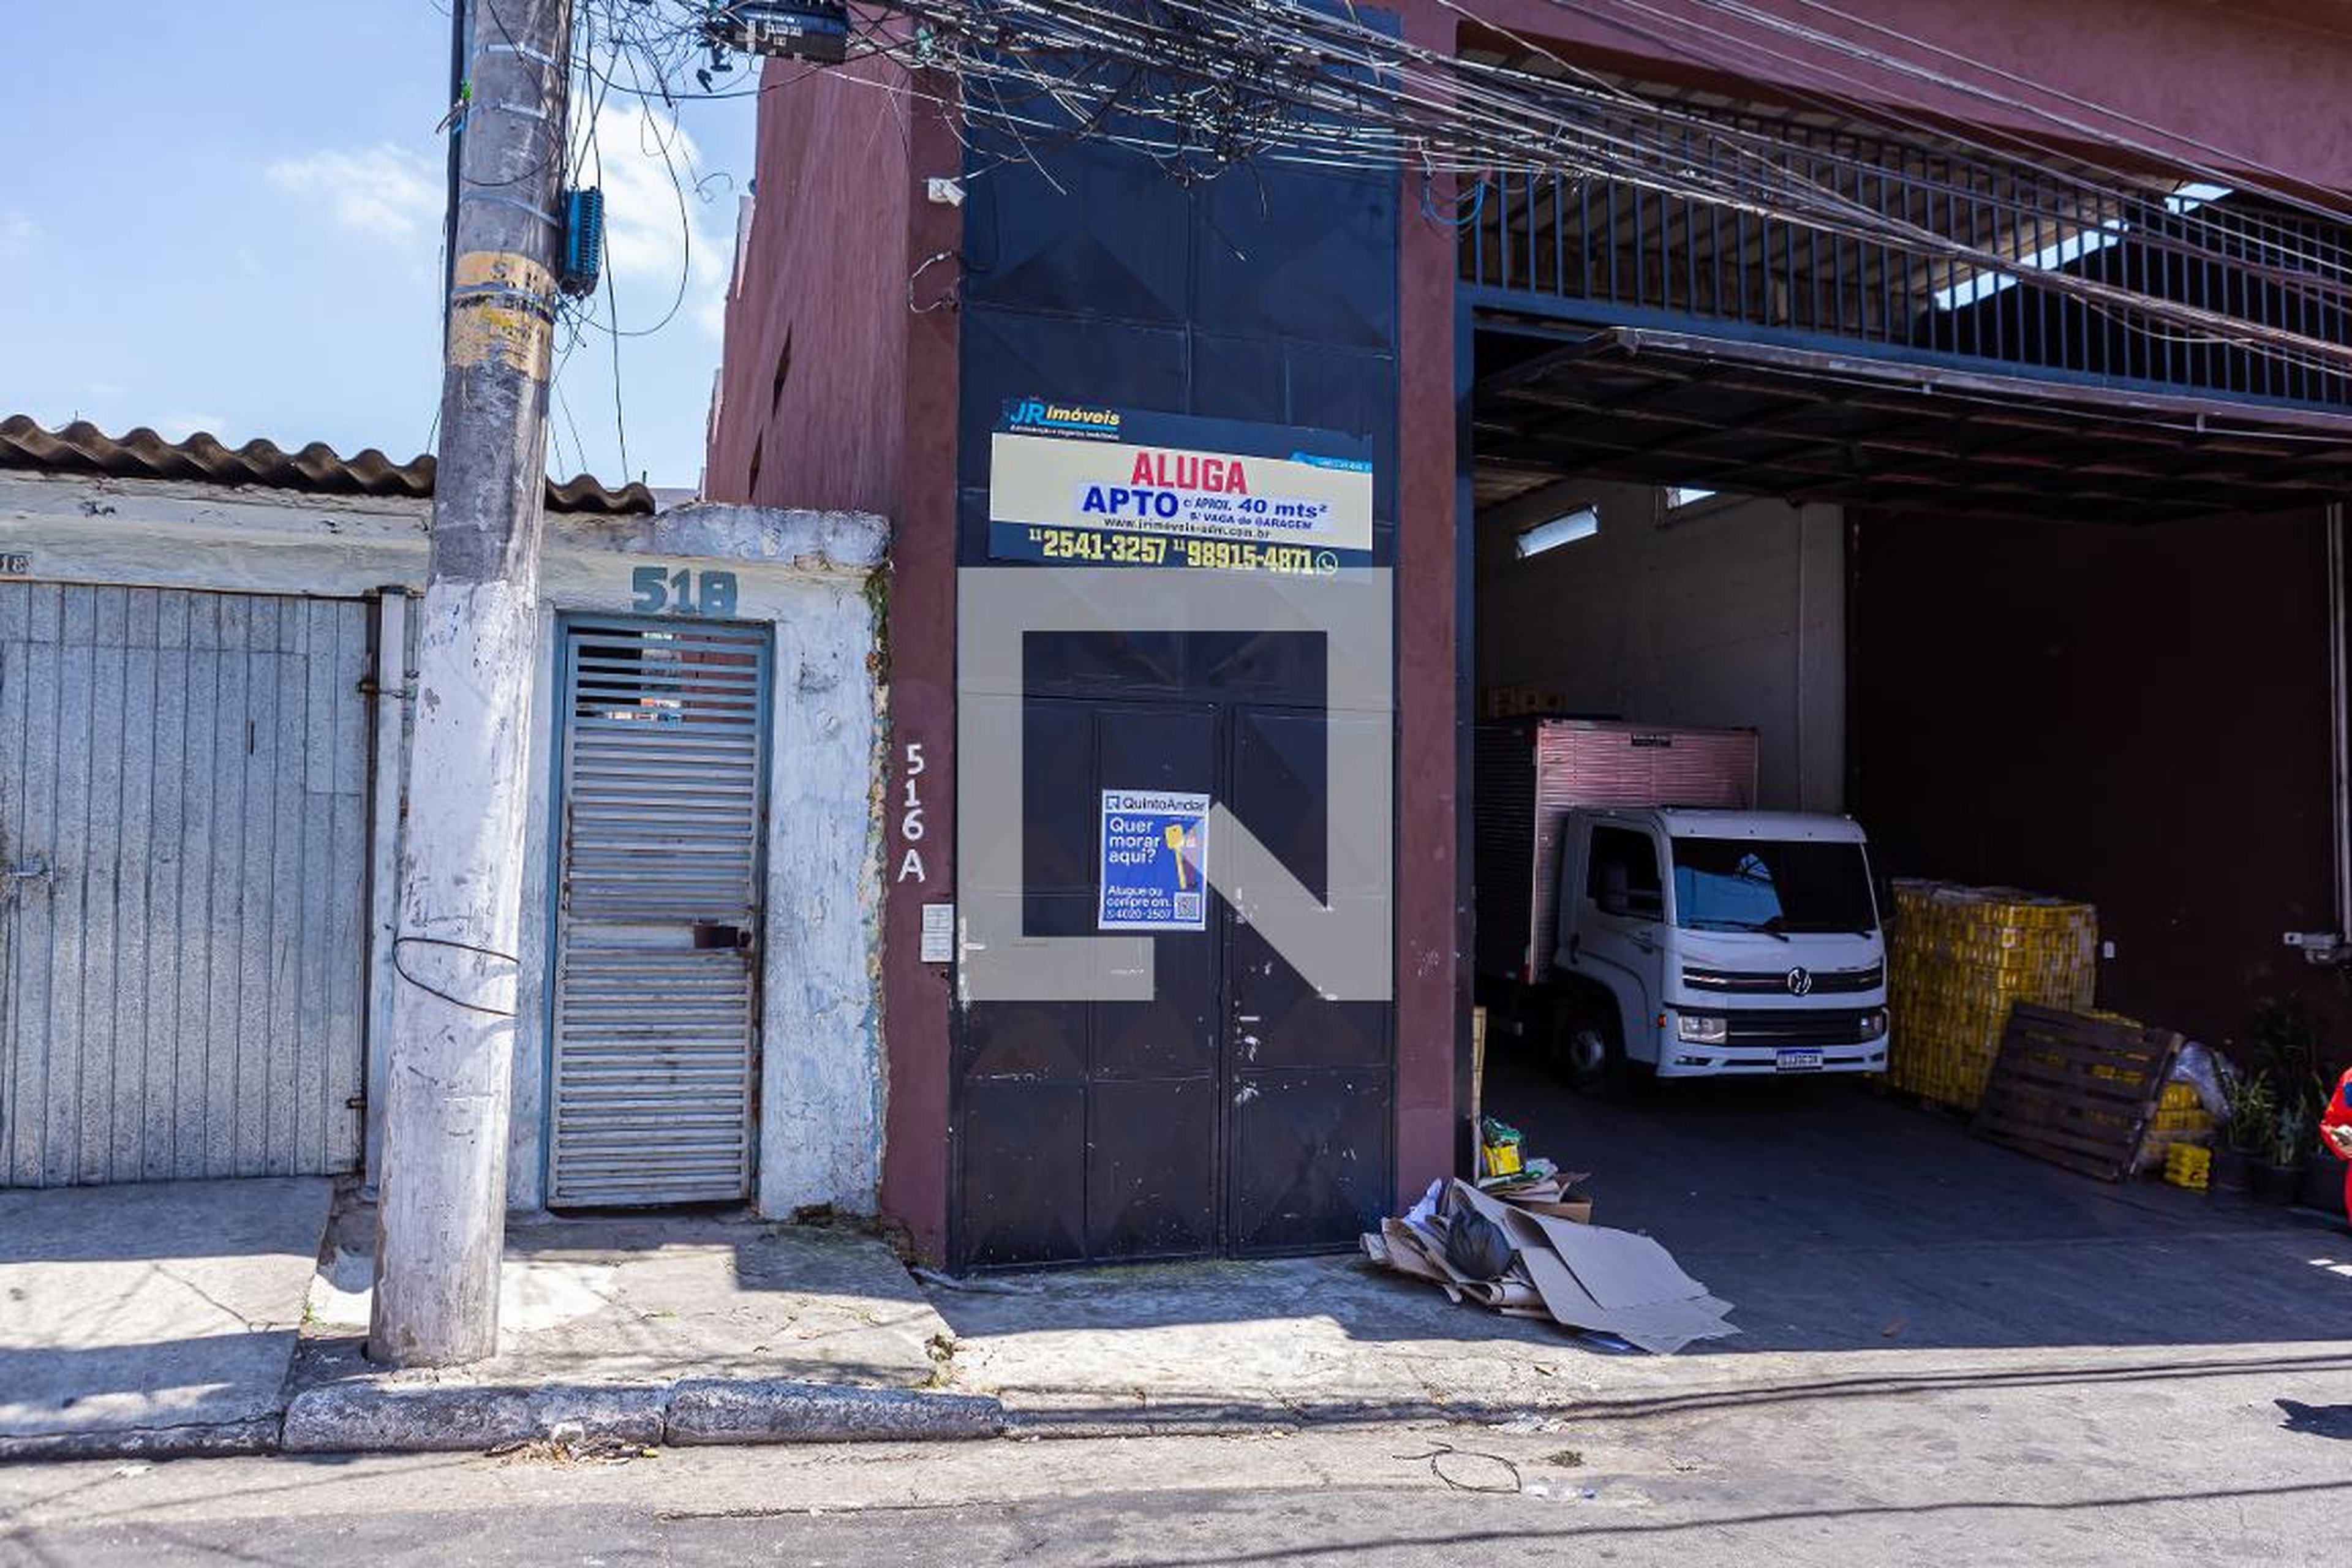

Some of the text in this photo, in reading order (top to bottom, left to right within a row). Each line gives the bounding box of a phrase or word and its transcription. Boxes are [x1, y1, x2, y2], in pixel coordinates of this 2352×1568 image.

[1011, 402, 1045, 424] JR
[1131, 452, 1248, 494] ALUGA
[1083, 486, 1178, 518] APTO
[1237, 498, 1267, 514] 40
[1204, 513, 1235, 524] VAGA
[1029, 529, 1041, 540] 11
[1043, 529, 1167, 564] 2541-3257
[633, 566, 738, 617] 518
[1110, 817, 1154, 833] Quer
[1109, 835, 1161, 848] morar
[1109, 848, 1156, 866] aqui?
